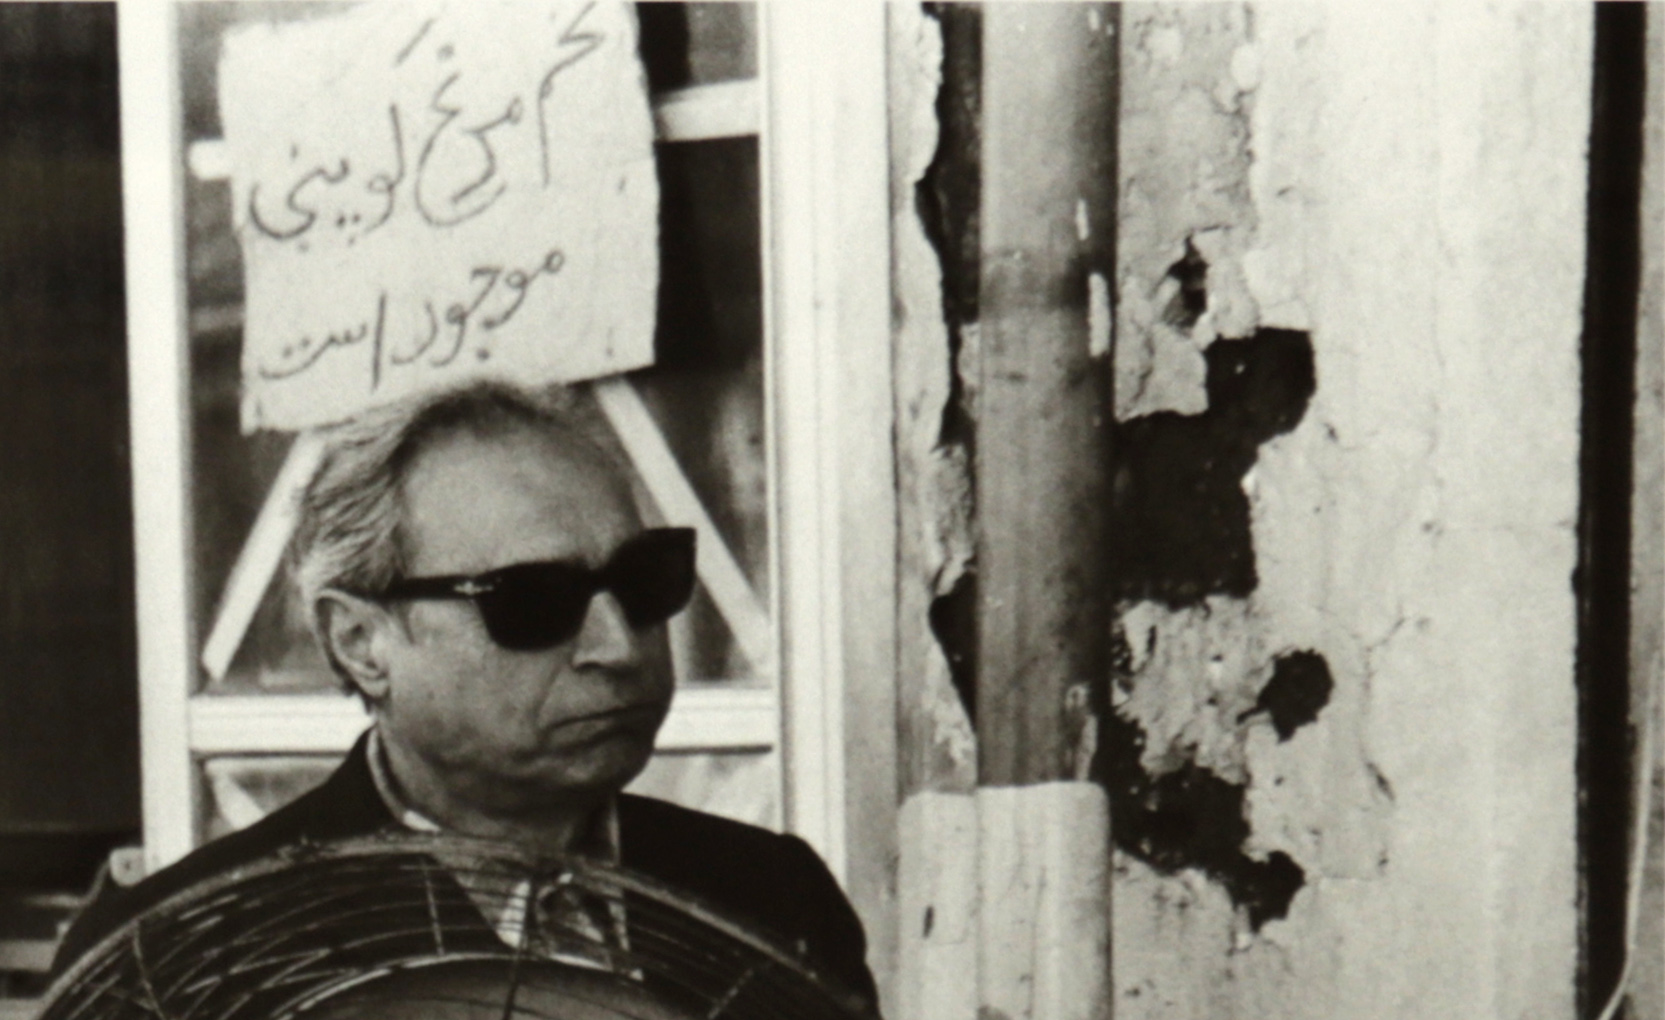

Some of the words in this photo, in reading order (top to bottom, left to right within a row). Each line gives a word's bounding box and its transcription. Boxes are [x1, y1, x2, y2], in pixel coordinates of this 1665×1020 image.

[414, 42, 524, 228] مرغ
[258, 290, 386, 391] است
[391, 248, 566, 368] موجود
